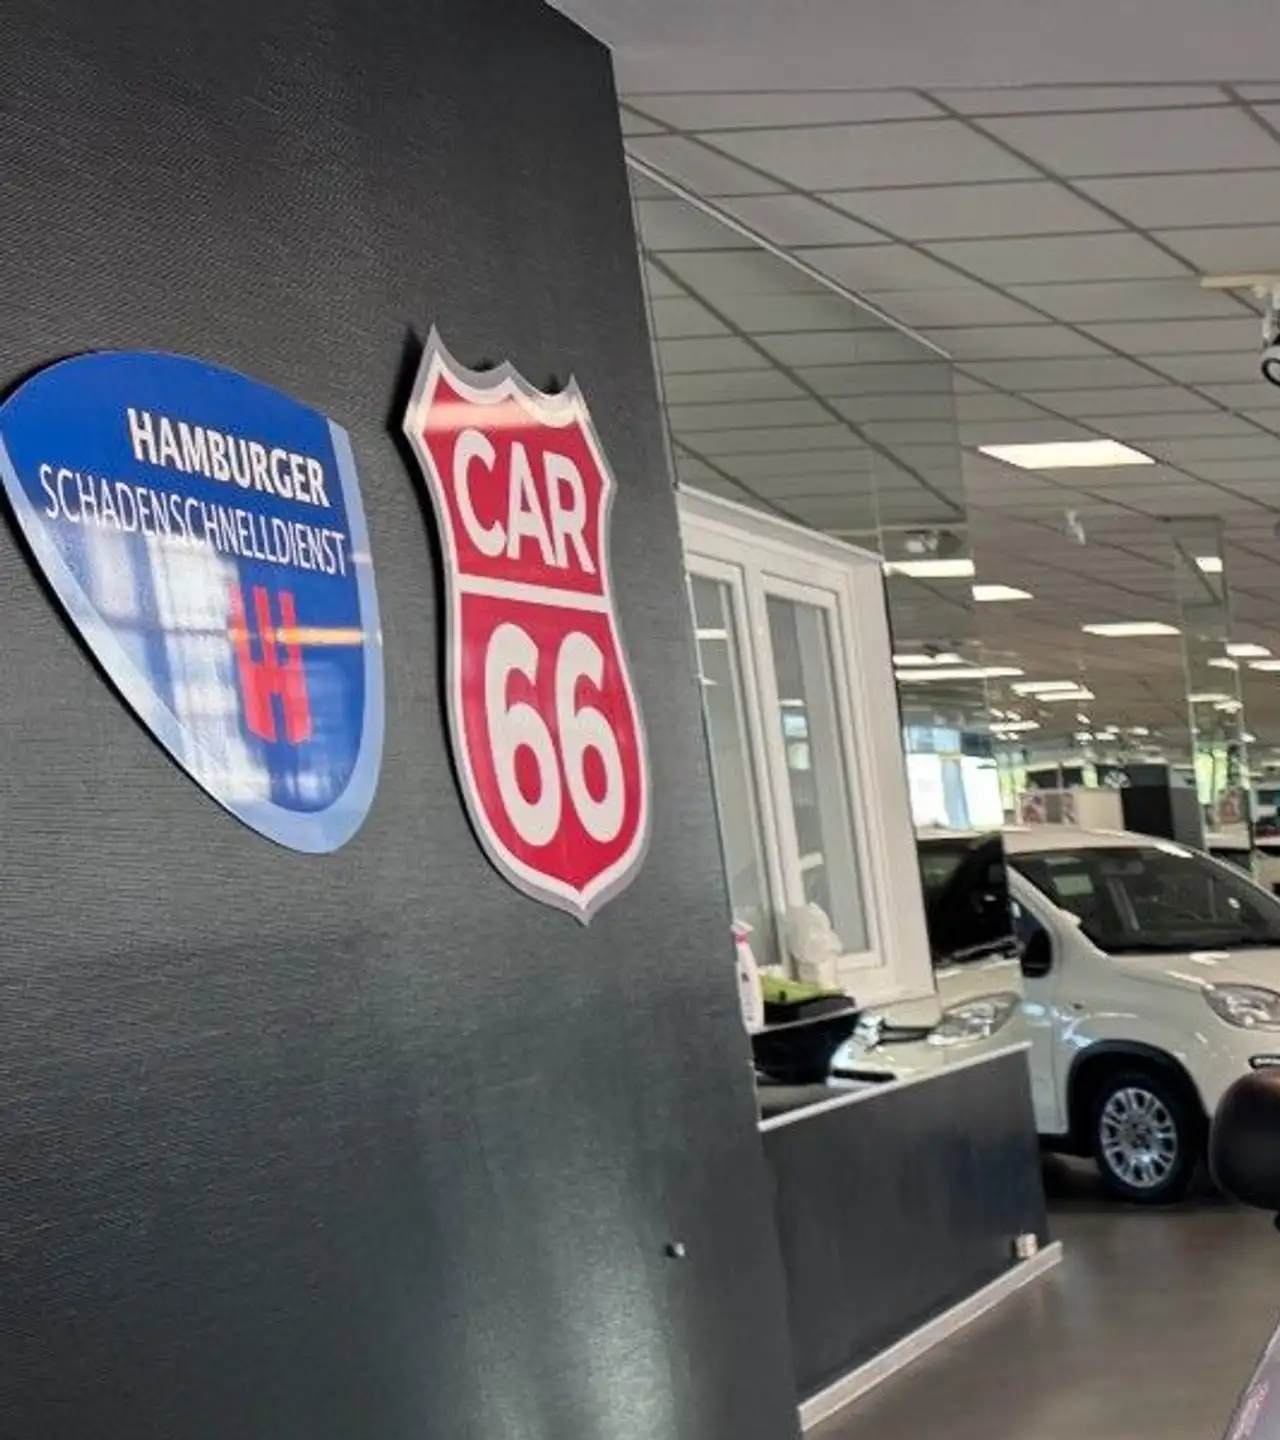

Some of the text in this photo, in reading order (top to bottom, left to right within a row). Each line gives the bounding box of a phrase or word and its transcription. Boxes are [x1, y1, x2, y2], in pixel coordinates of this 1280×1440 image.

[39, 463, 348, 576] SCHADENSCHNELLDIENST
[126, 407, 331, 508] HAMBURGER
[453, 428, 596, 575] CAR
[485, 623, 625, 847] 66
